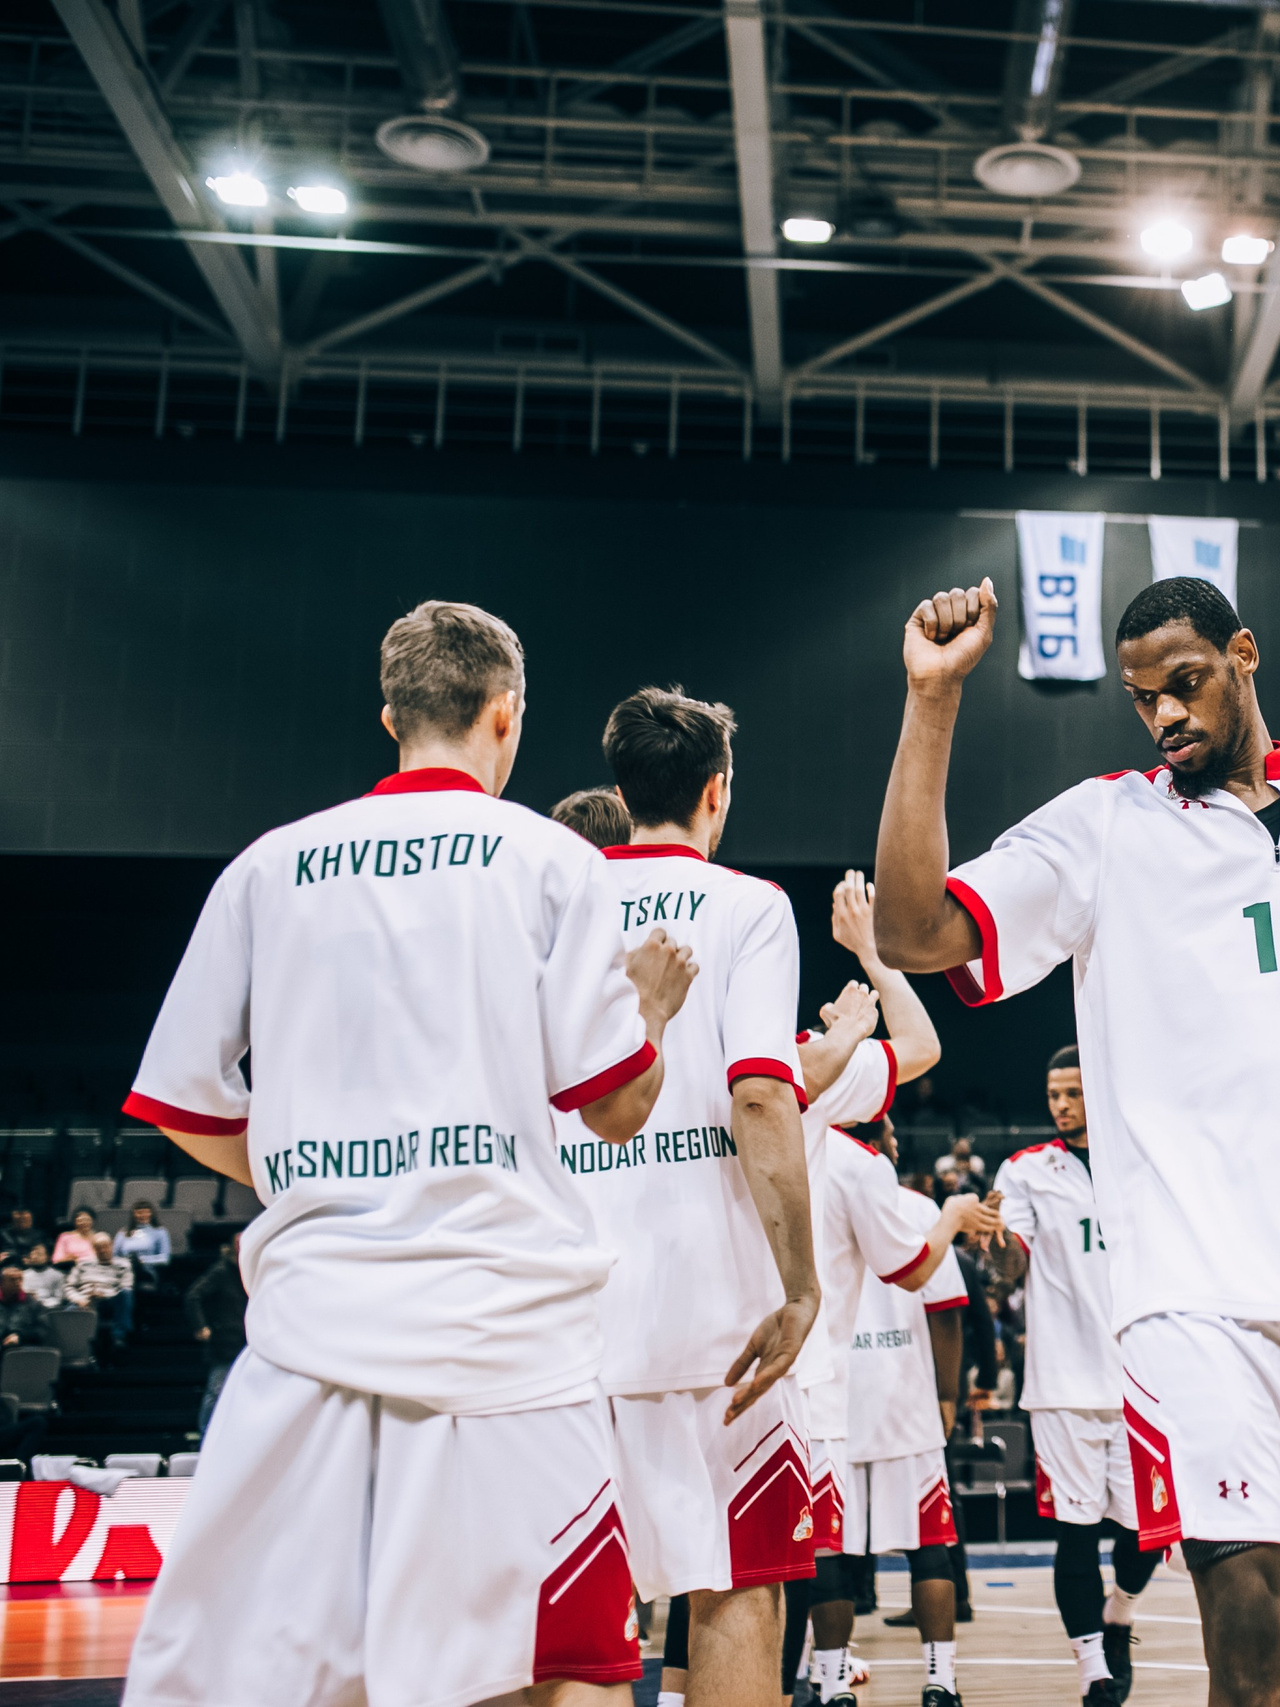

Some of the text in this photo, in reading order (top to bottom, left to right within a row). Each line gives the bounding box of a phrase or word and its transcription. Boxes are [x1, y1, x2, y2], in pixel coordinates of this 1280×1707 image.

[1038, 574, 1078, 659] ВТБ
[295, 833, 503, 886] KHVOSTOV
[620, 890, 707, 931] TSKIY
[264, 1130, 420, 1194] KRSNODAR
[560, 1126, 738, 1174] NODAR REGION
[851, 1332, 872, 1350] AR
